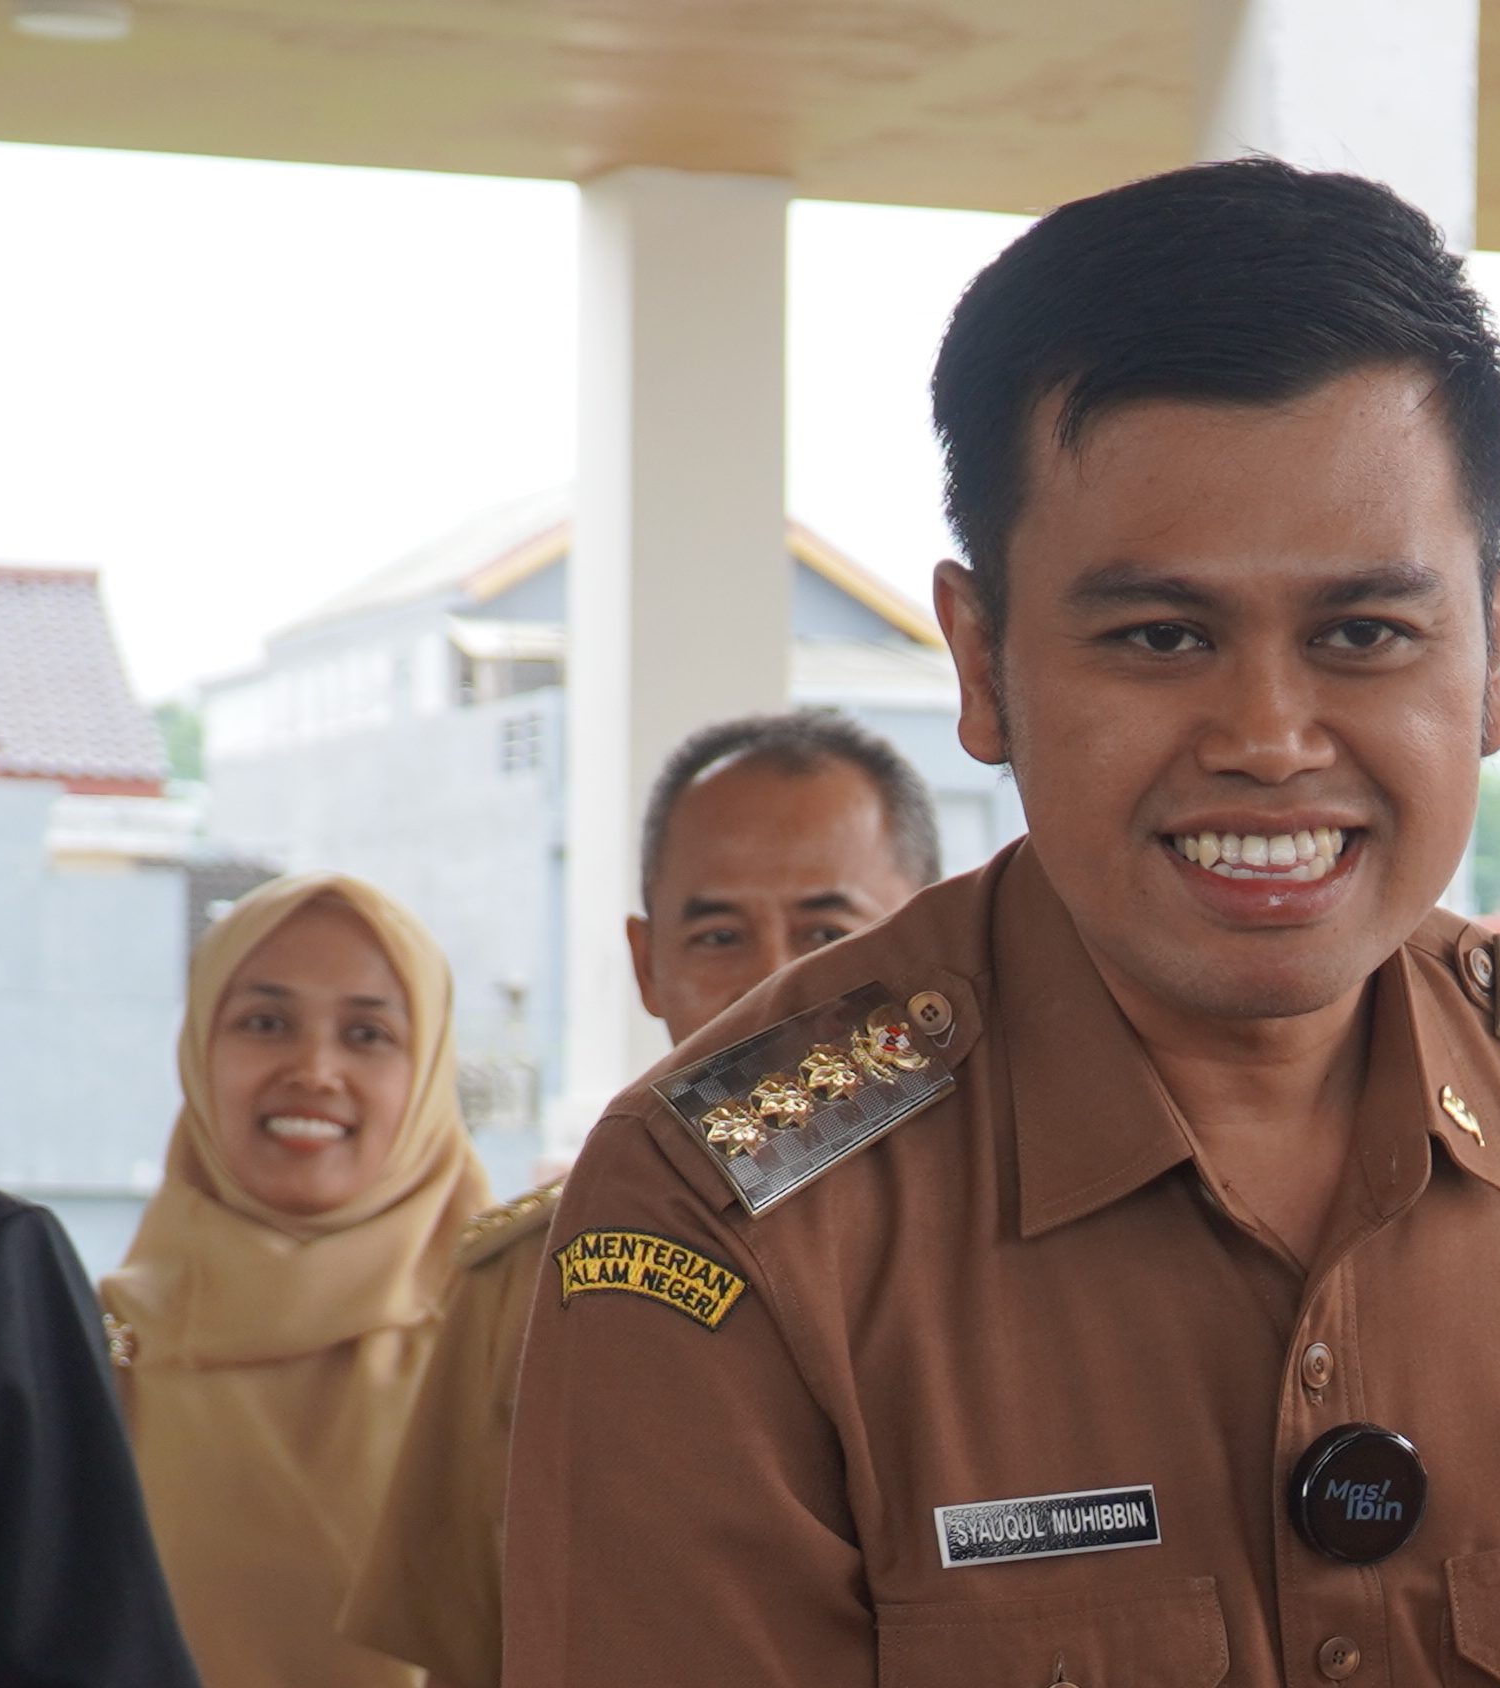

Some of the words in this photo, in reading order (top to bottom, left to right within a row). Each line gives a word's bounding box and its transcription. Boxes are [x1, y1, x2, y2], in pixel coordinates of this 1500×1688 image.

[641, 1267, 719, 1319] NEGERI
[956, 1511, 1045, 1547] SYAUQUL
[1051, 1501, 1147, 1536] MUHIBBIN
